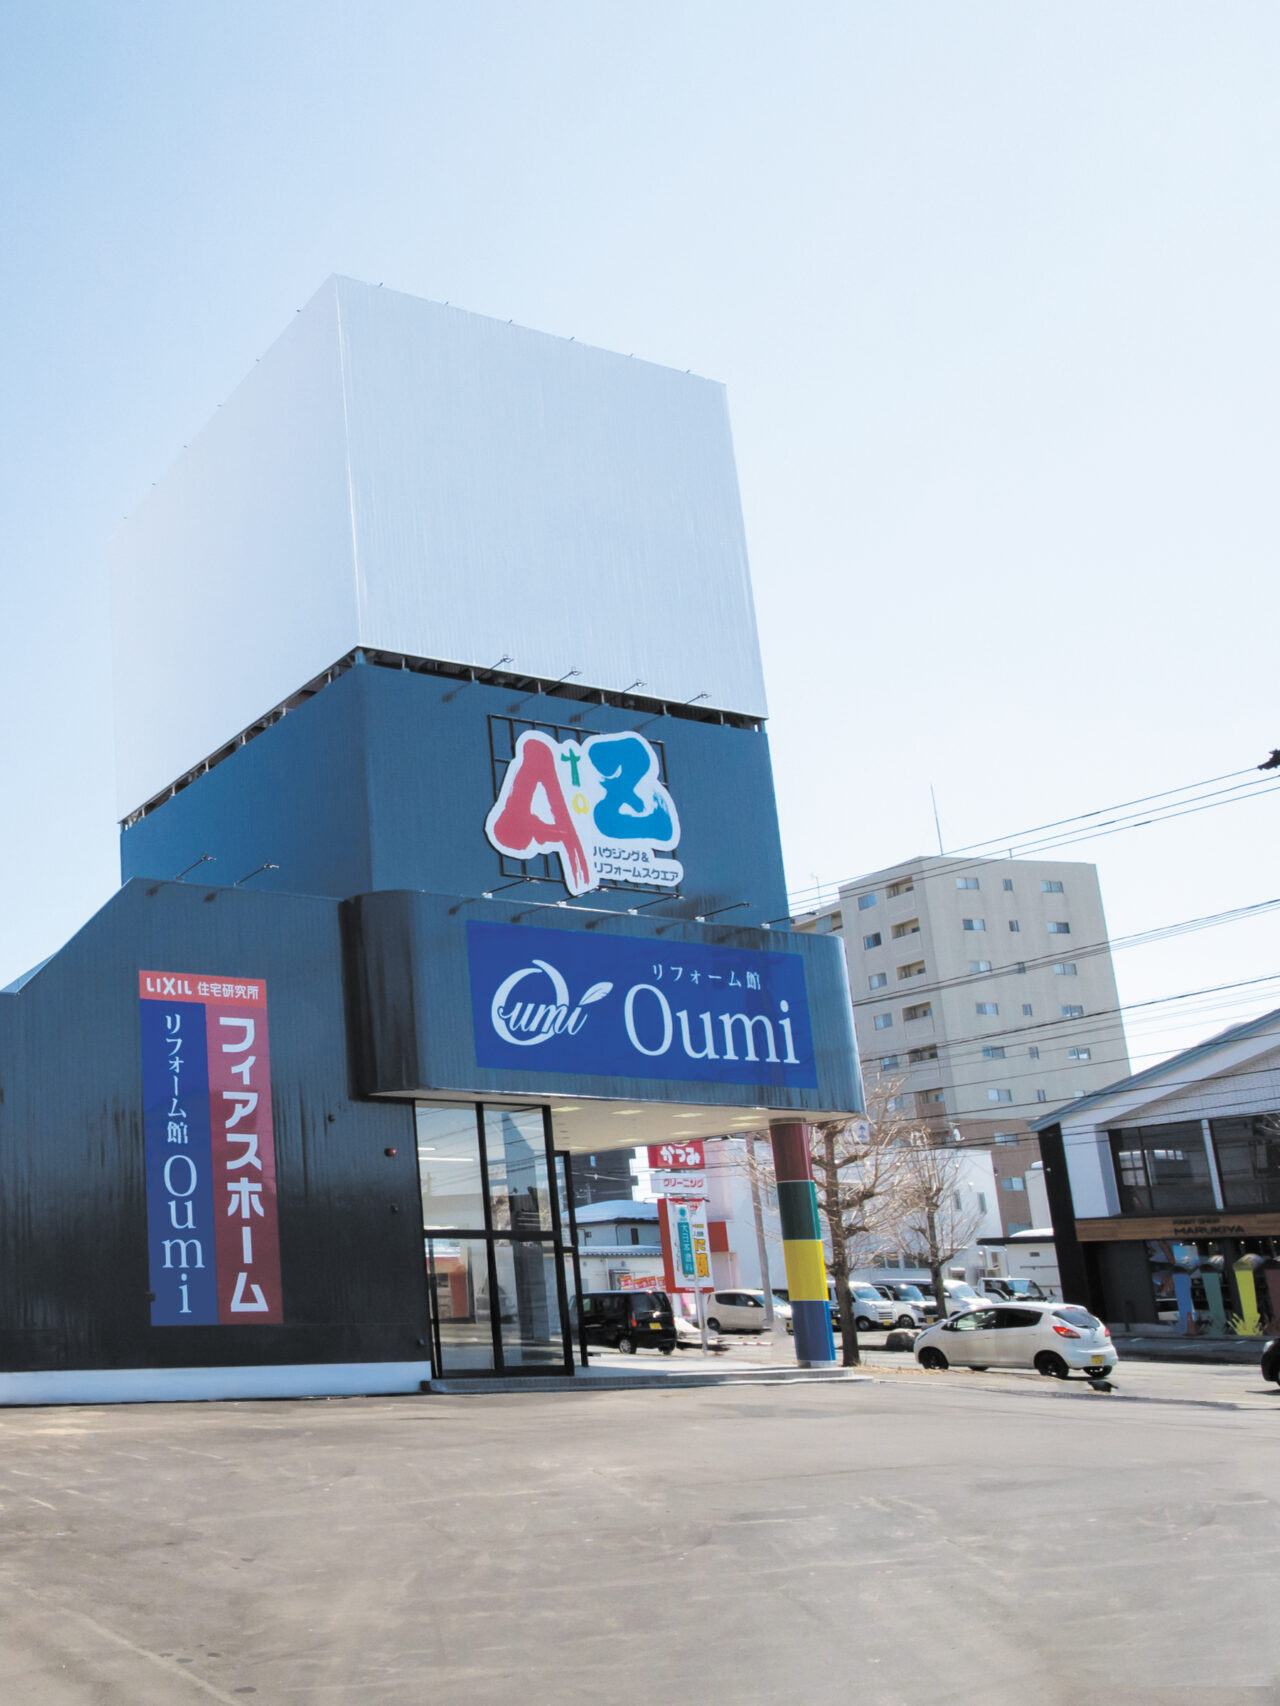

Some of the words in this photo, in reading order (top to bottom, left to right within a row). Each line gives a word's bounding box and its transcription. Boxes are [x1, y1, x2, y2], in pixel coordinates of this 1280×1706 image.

[593, 846, 649, 863] ハウジング&
[594, 862, 679, 882] リフォームスクエア
[146, 977, 192, 996] LIXIL
[197, 981, 260, 1000] 住宅研究所
[652, 963, 762, 990] リフォーム館
[624, 983, 801, 1064] Oumi
[164, 1012, 189, 1145] リフォーム館
[218, 1016, 270, 1314] フィアスホーム
[663, 1177, 705, 1189] クリーニング
